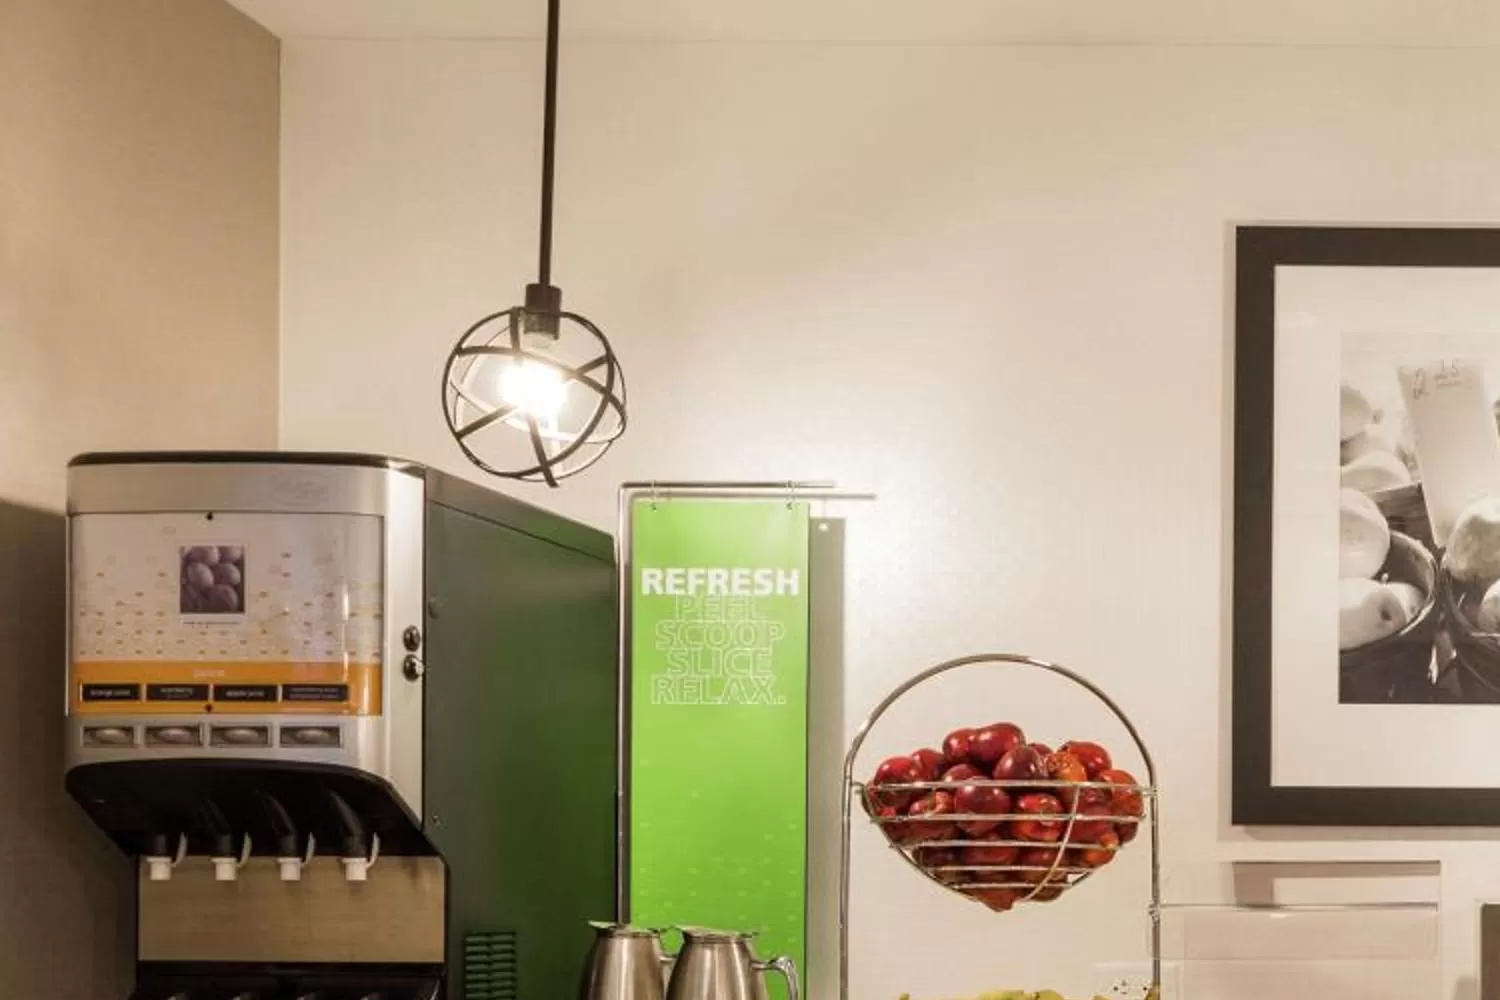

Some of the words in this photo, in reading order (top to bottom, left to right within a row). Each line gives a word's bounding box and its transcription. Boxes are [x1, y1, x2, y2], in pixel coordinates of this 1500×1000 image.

[640, 567, 799, 596] REFRESH
[675, 592, 770, 622] PEEL
[655, 620, 786, 649] SCOOP
[665, 648, 774, 677] SLICE
